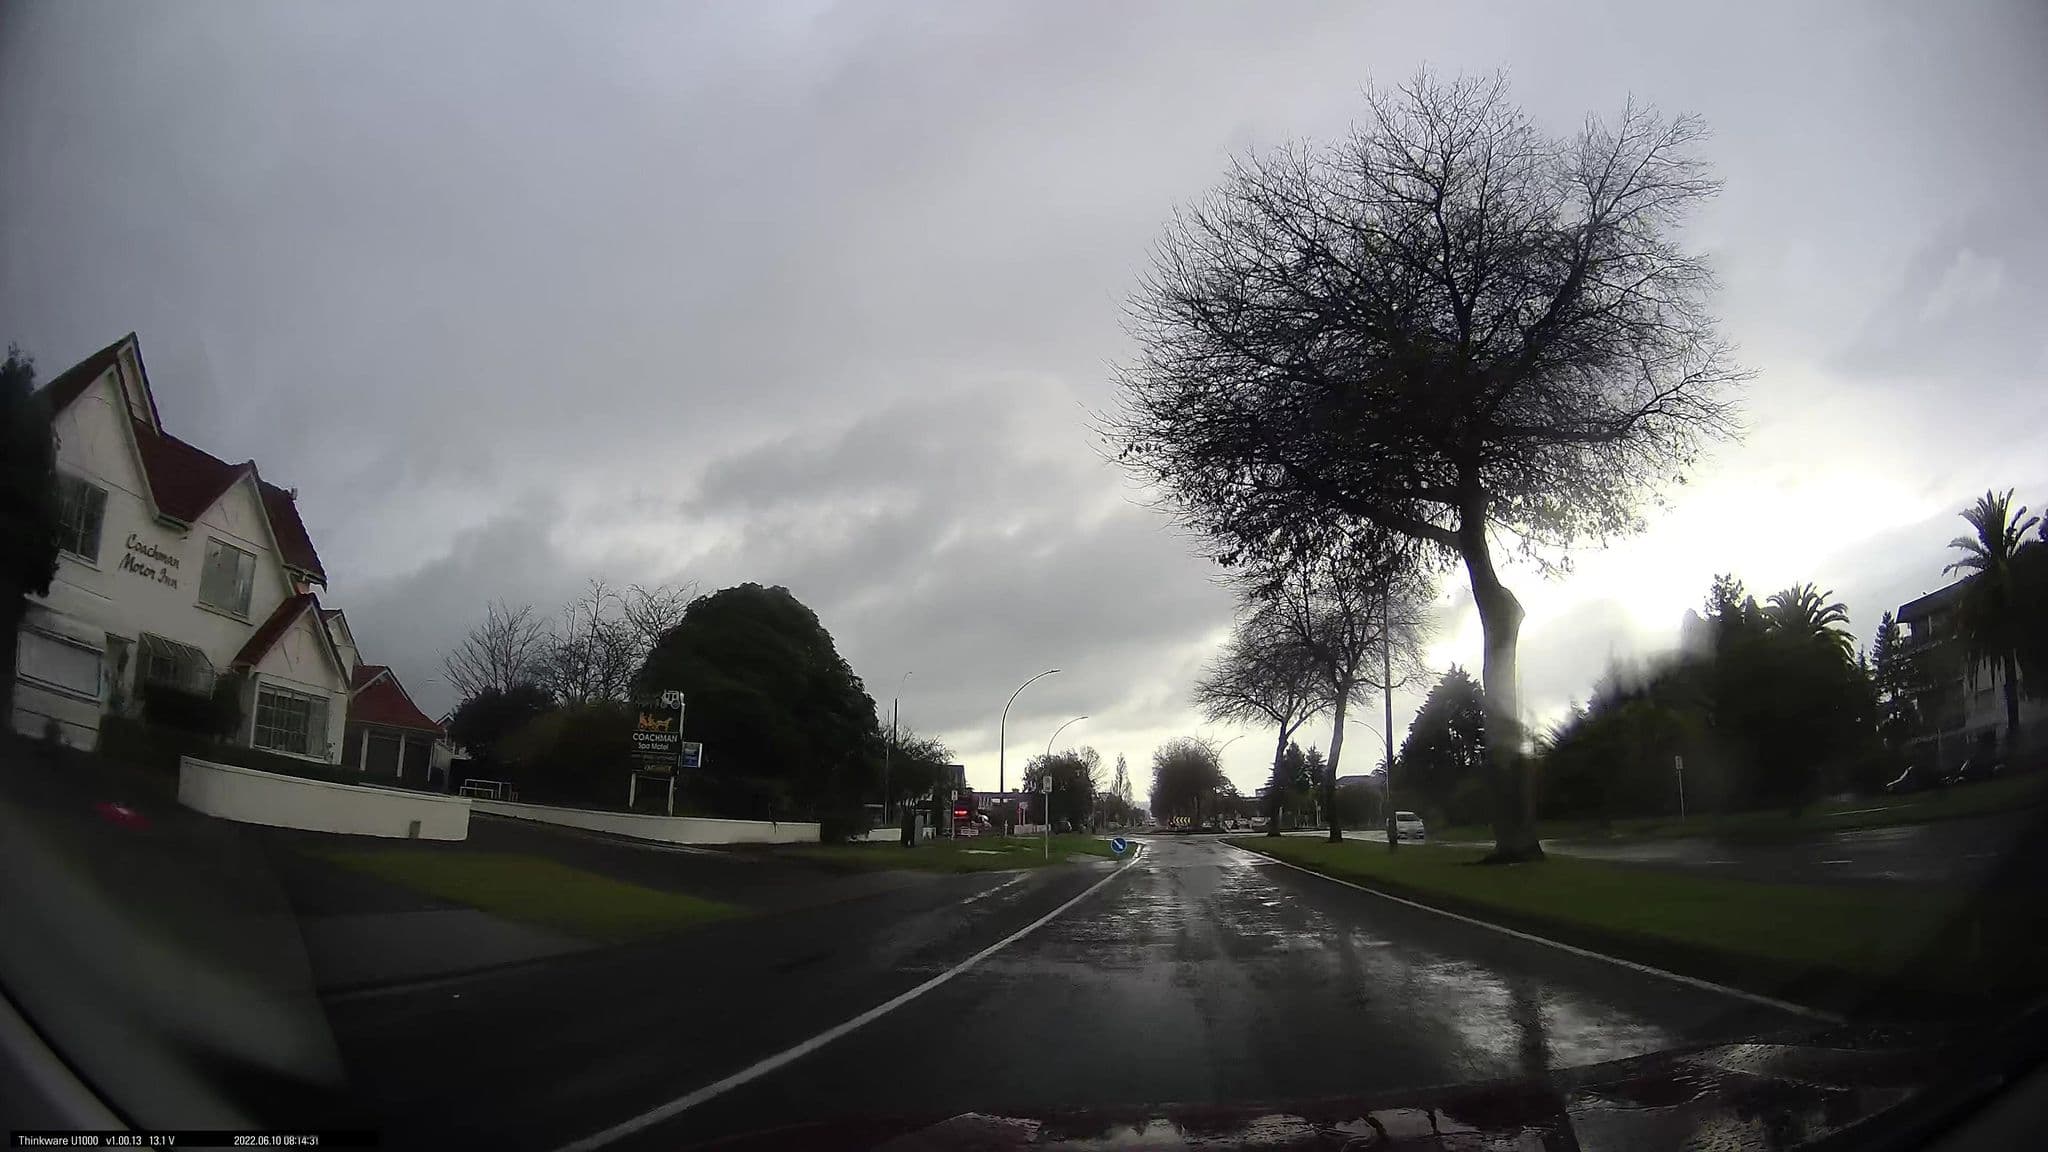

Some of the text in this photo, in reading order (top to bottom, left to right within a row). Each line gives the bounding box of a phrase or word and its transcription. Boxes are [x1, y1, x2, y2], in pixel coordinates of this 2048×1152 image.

[126, 534, 180, 569] Coachman
[118, 553, 178, 590] Motor Inn
[632, 733, 678, 742] COACHMAN
